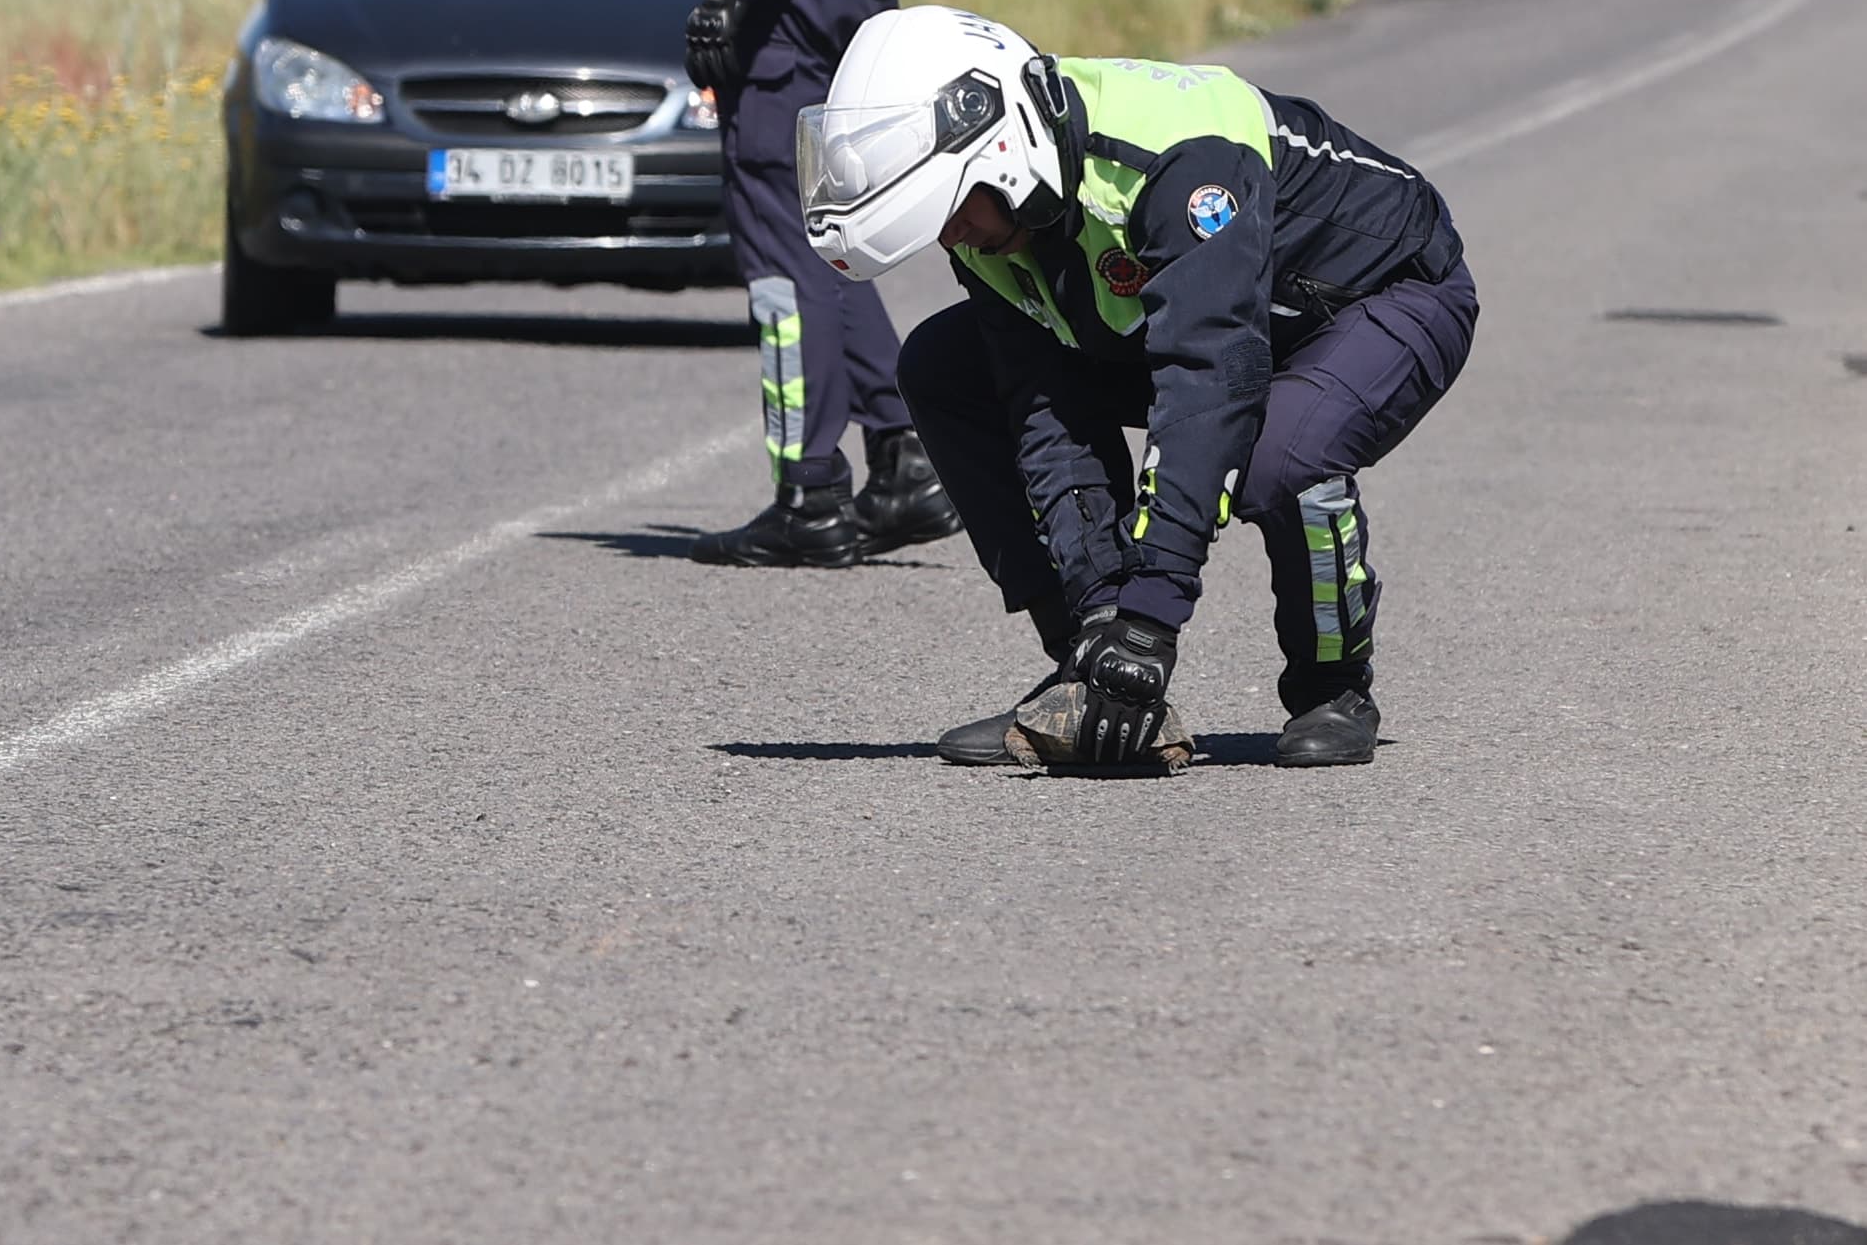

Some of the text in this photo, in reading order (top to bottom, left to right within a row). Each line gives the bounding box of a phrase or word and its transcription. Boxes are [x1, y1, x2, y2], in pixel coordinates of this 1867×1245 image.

[449, 157, 622, 187] 34 DZ 8015
